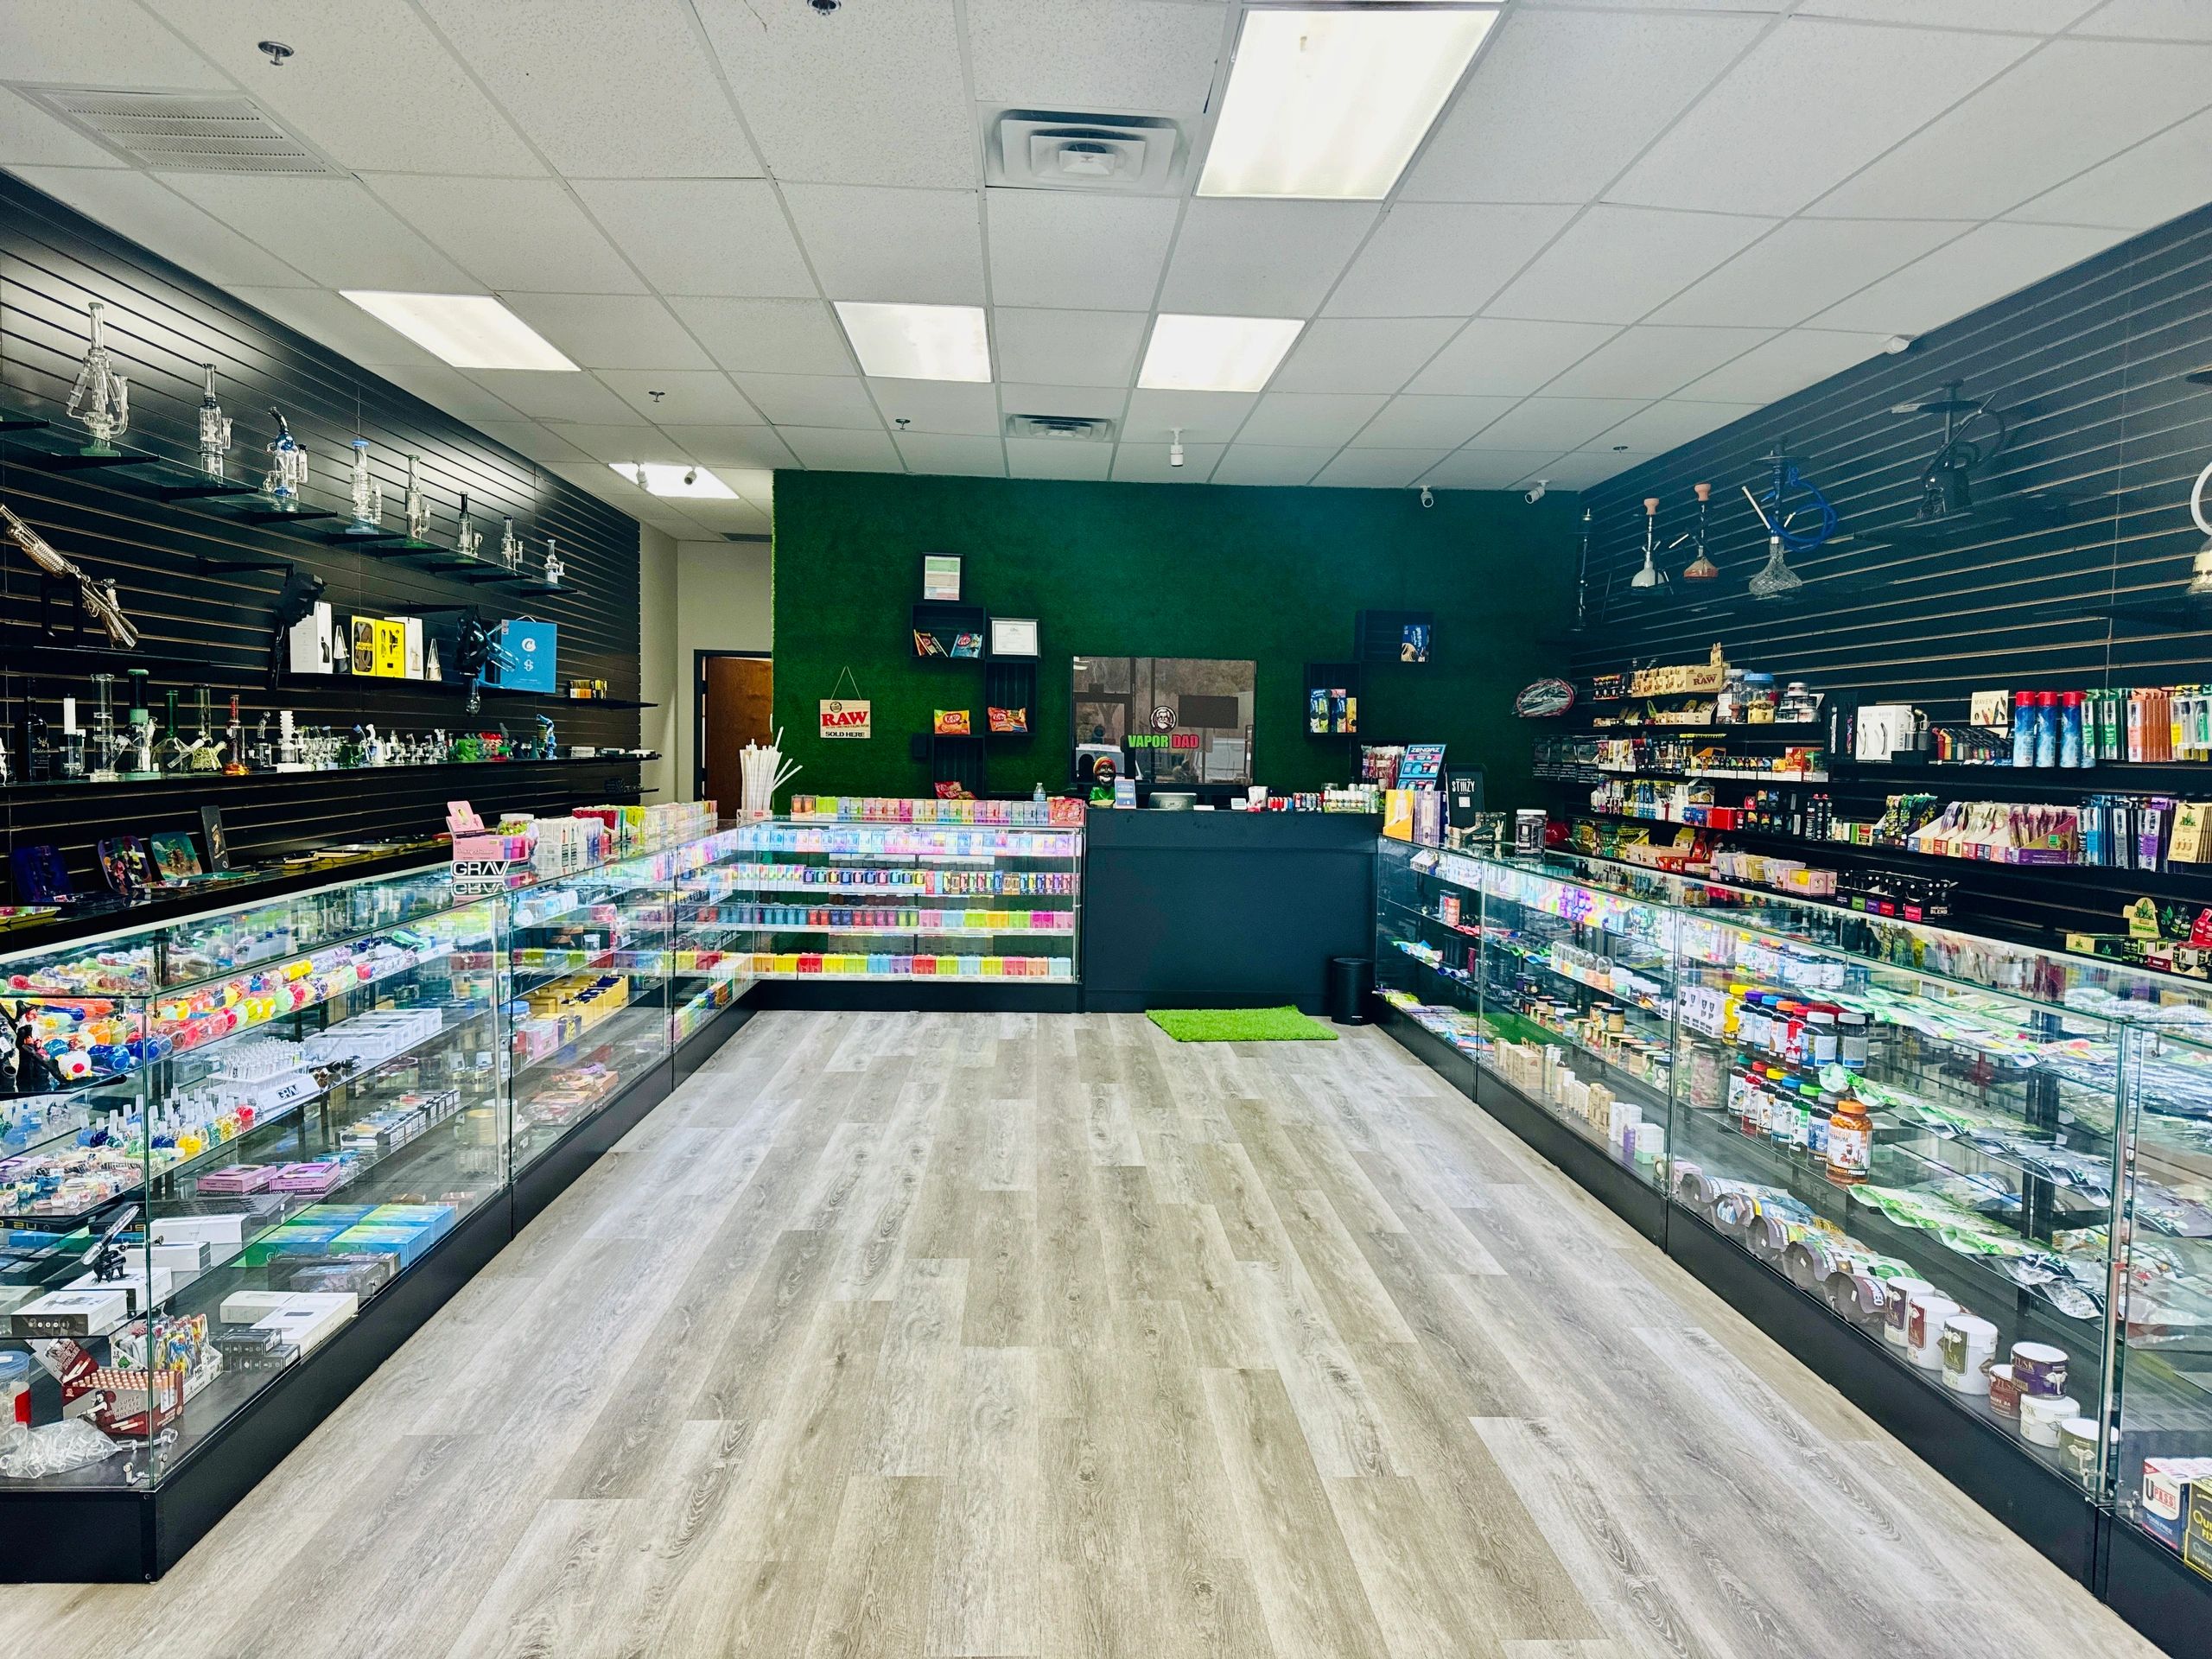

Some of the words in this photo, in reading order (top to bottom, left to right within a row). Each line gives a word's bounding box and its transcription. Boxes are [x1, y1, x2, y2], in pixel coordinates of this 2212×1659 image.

[1694, 677, 1717, 686] RAW
[821, 711, 869, 727] RAW
[1128, 734, 1169, 748] VAPOR
[1172, 734, 1200, 748] DAD
[453, 861, 508, 875] GRAV
[2014, 1356, 2034, 1372] TUSK
[2154, 1487, 2176, 1508] PASS
